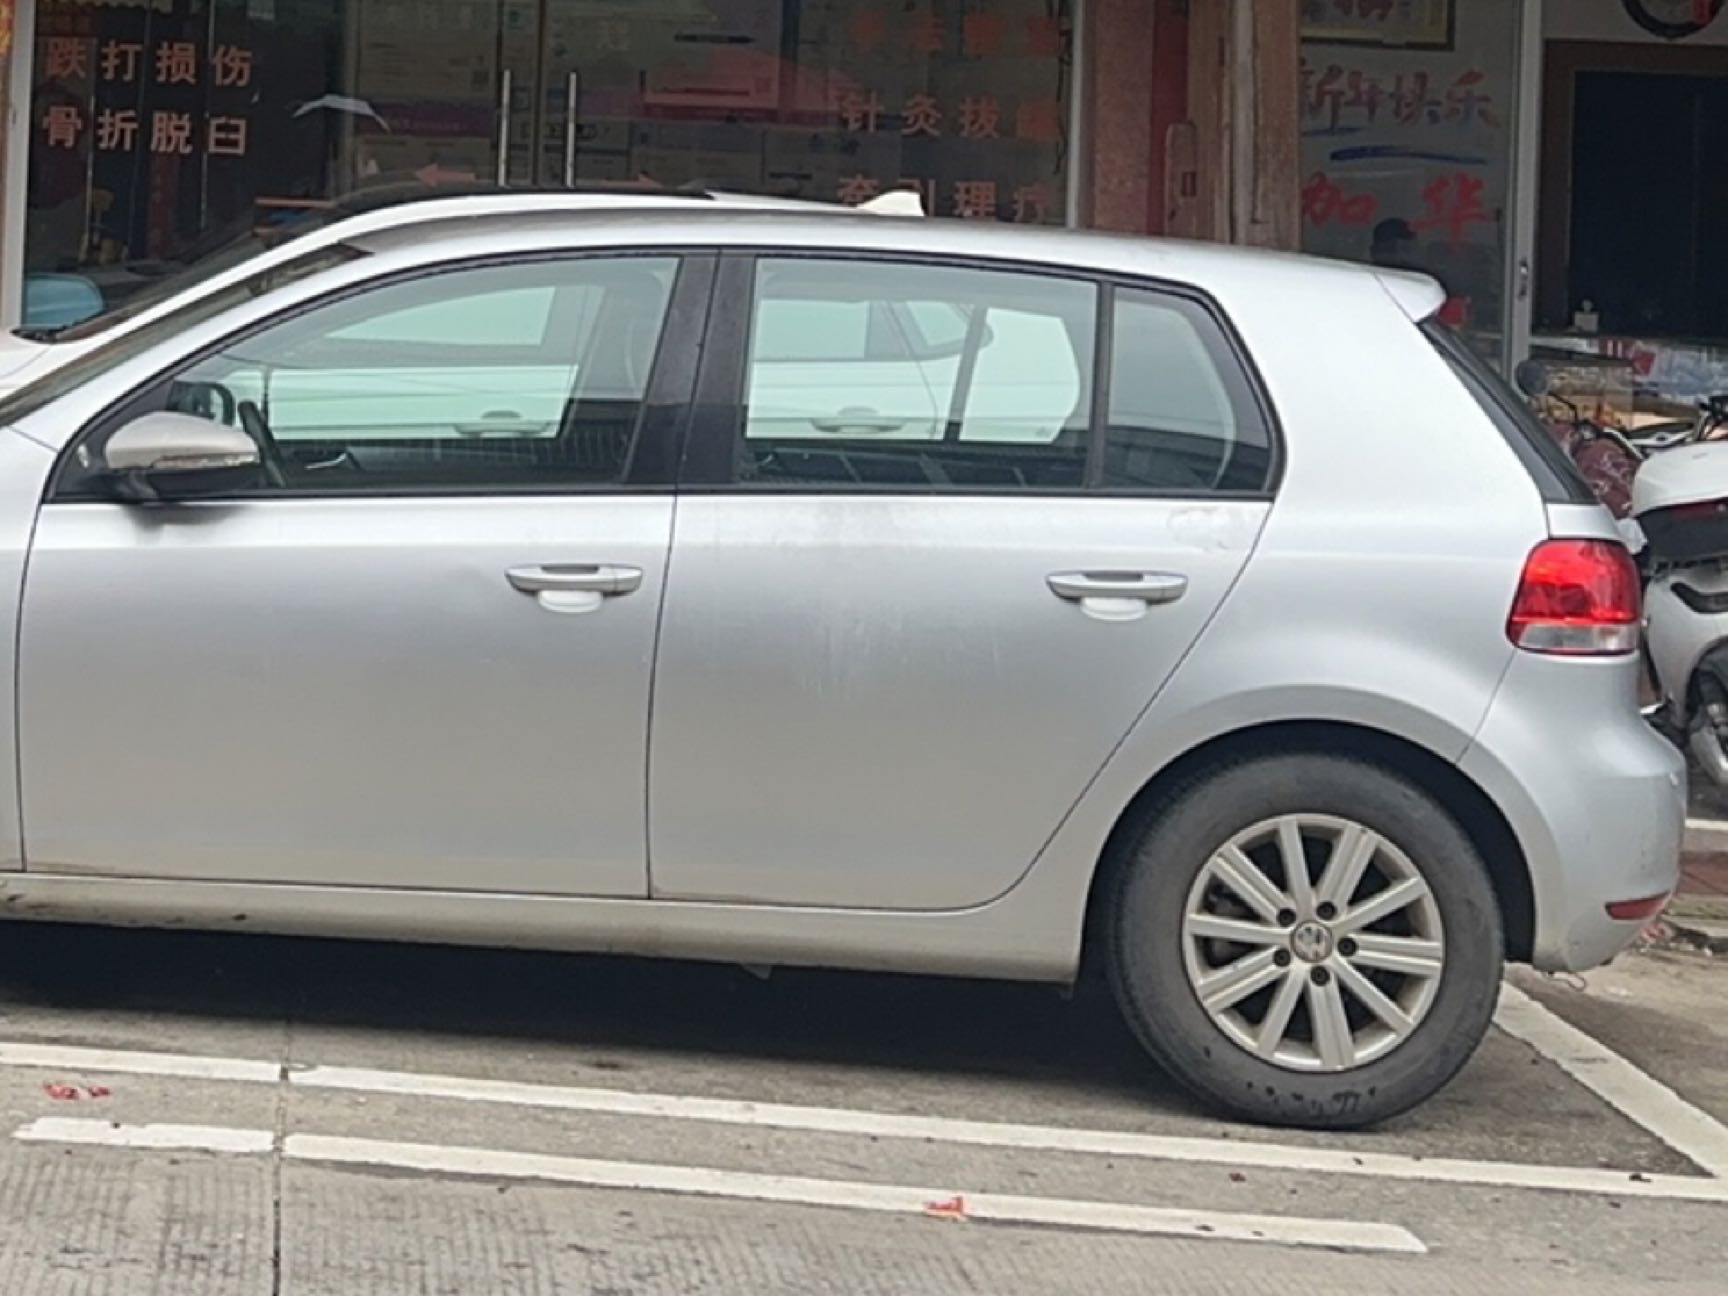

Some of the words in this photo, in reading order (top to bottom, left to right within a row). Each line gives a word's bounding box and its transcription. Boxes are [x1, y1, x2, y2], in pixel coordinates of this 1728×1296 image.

[45, 37, 254, 87] 跌打损伤
[42, 103, 249, 157] 骨折脱臼
